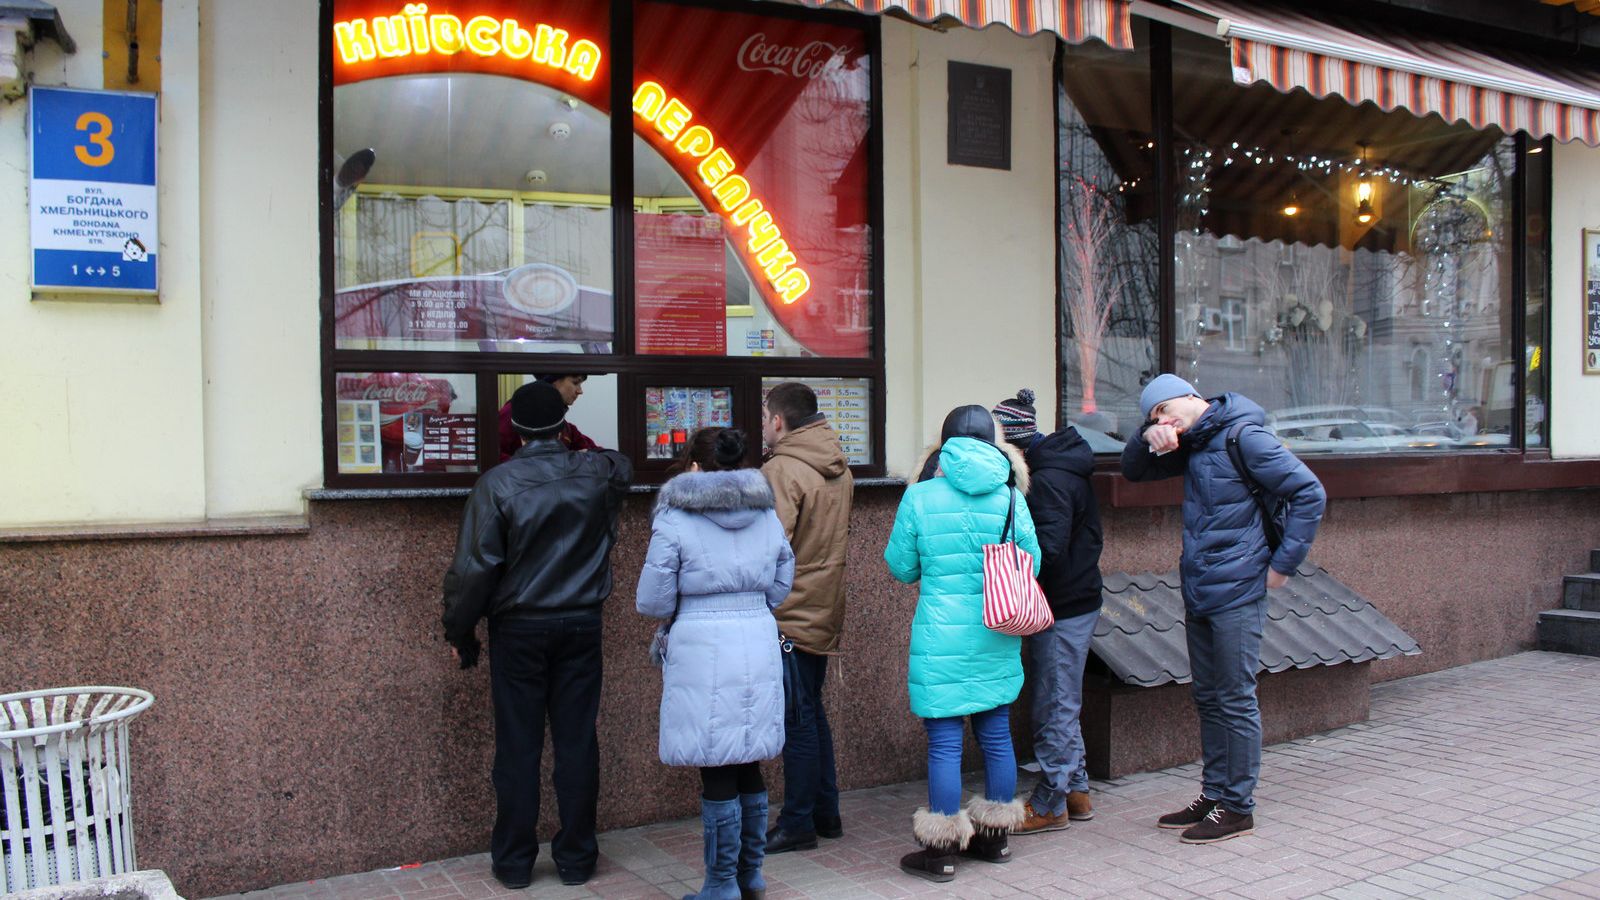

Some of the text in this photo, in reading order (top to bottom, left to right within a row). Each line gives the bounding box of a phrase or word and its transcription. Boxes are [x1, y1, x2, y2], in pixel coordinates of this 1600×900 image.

[74, 111, 115, 167] 3
[633, 81, 811, 305] ПЕРЕПІЧКА
[66, 195, 123, 207] БОГДАНА
[40, 205, 149, 220] ХМЕЛЬНИЦЬКОГО
[73, 219, 120, 229] BOHDANA
[53, 228, 139, 239] KHMELNYTSKOHO
[72, 264, 121, 277] 1 5
